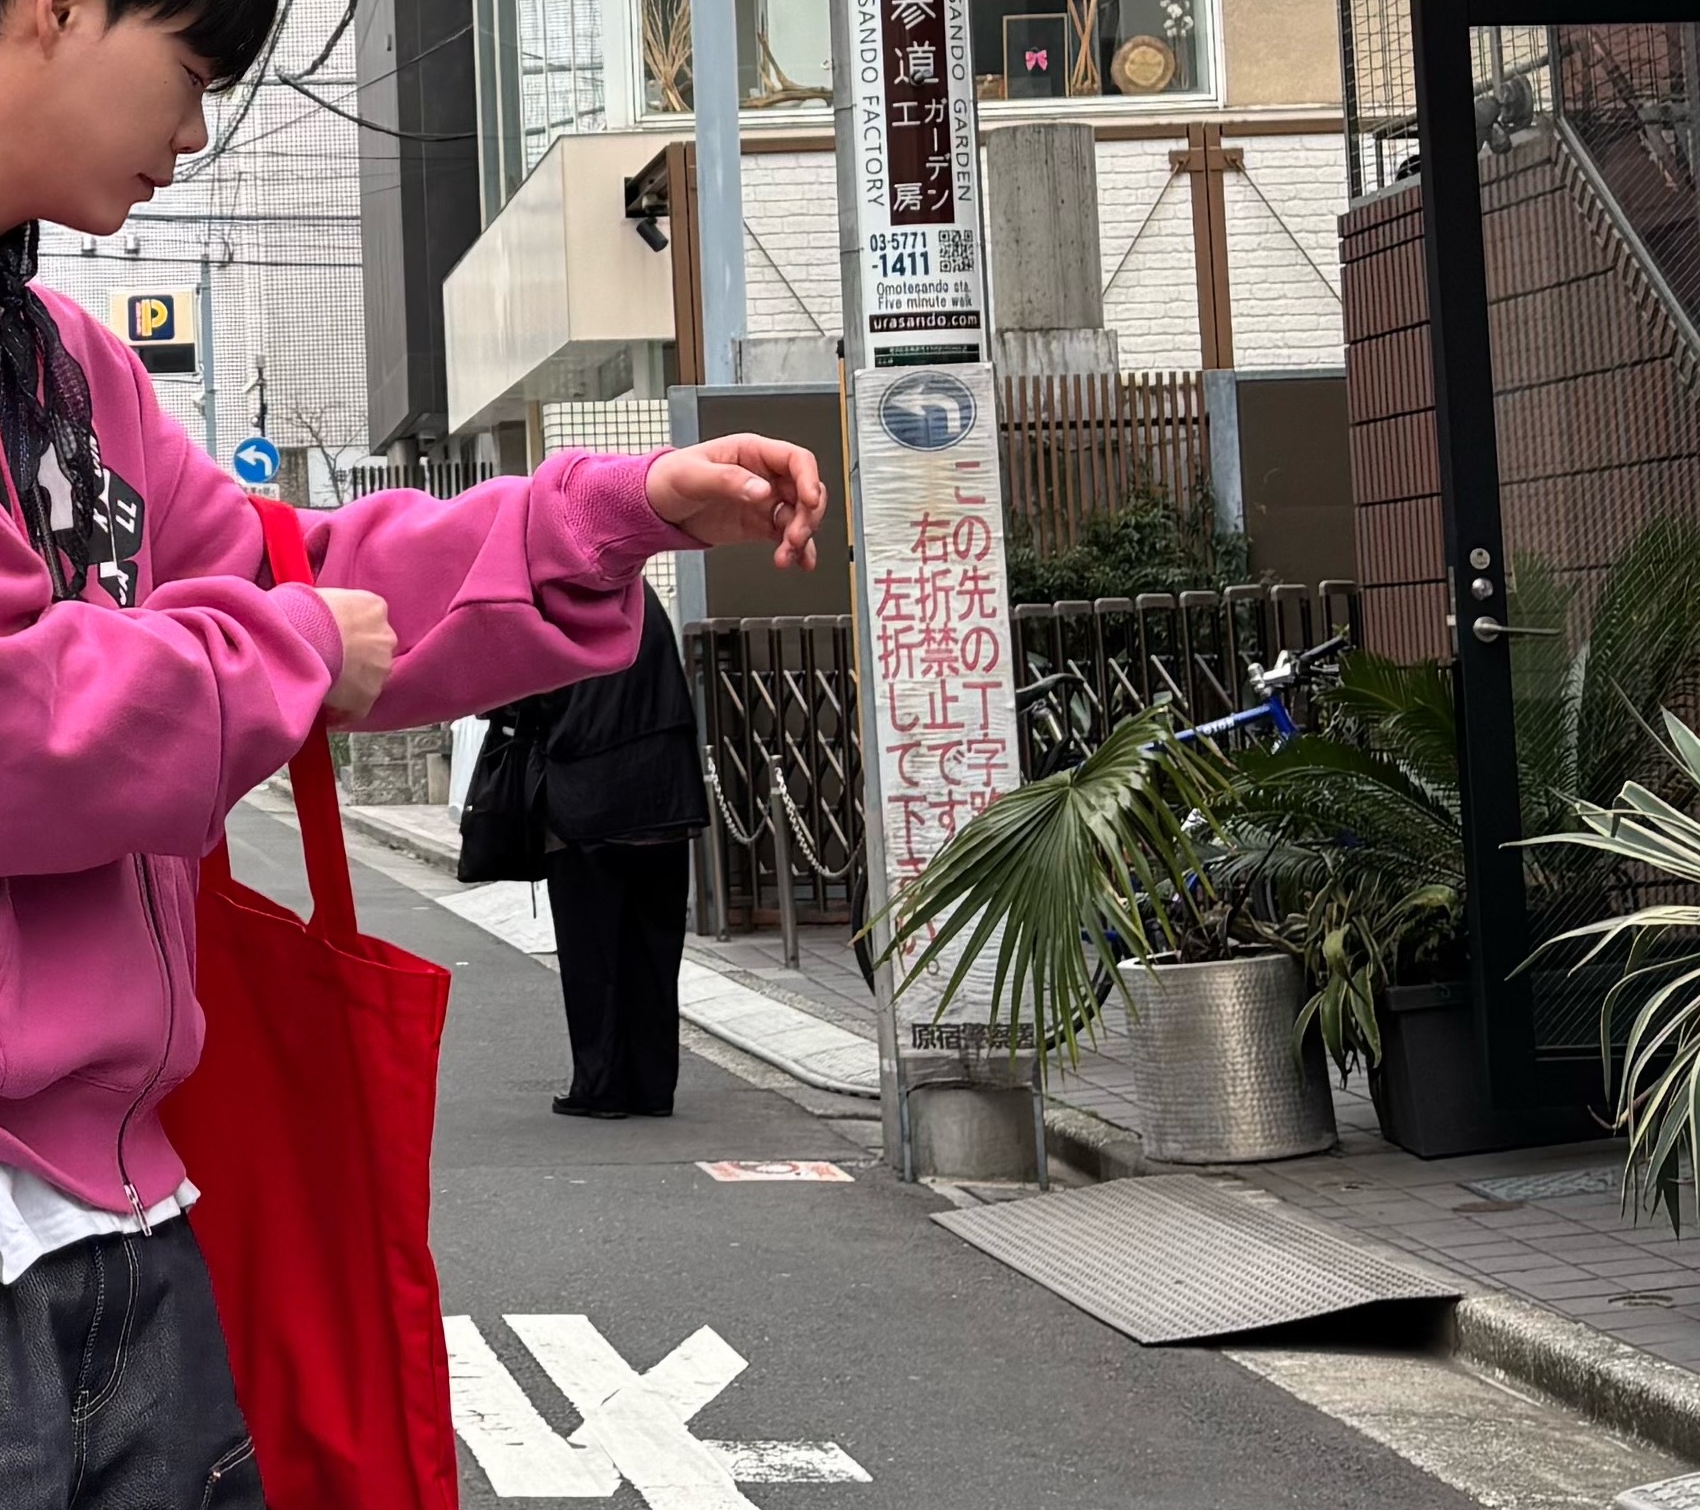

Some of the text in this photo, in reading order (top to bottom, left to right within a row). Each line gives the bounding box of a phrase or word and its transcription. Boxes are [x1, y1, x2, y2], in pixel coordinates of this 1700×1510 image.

[861, 94, 886, 208] FACTORY
[952, 98, 973, 203] GARDEN
[870, 231, 927, 252] 03-5771
